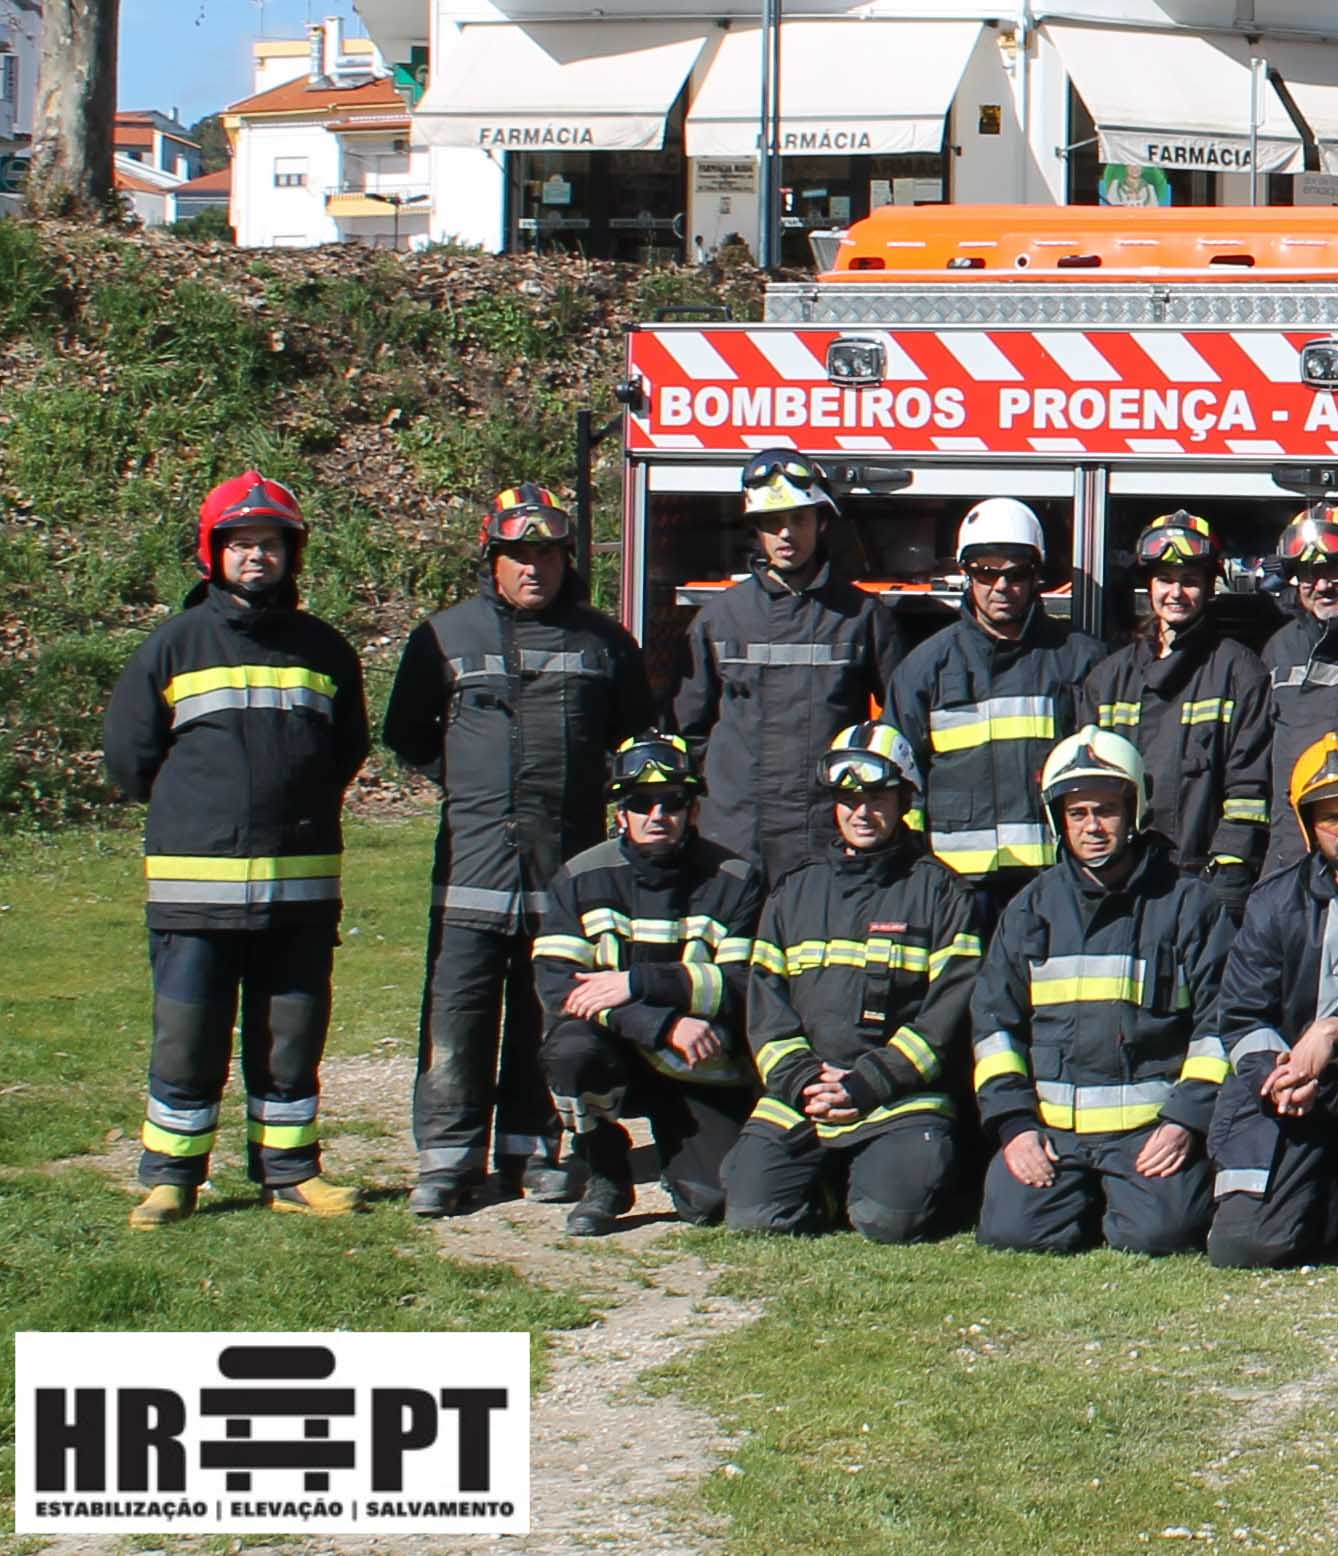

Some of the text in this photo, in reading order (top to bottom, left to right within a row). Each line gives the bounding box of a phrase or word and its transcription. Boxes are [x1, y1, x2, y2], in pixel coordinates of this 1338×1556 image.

[479, 123, 595, 145] FARMÁCIA
[757, 129, 872, 149] RMÁCIA
[1147, 144, 1252, 167] FARMÁCIA
[660, 386, 966, 429] BOMBEIROS
[999, 387, 1257, 441] PROENÇA
